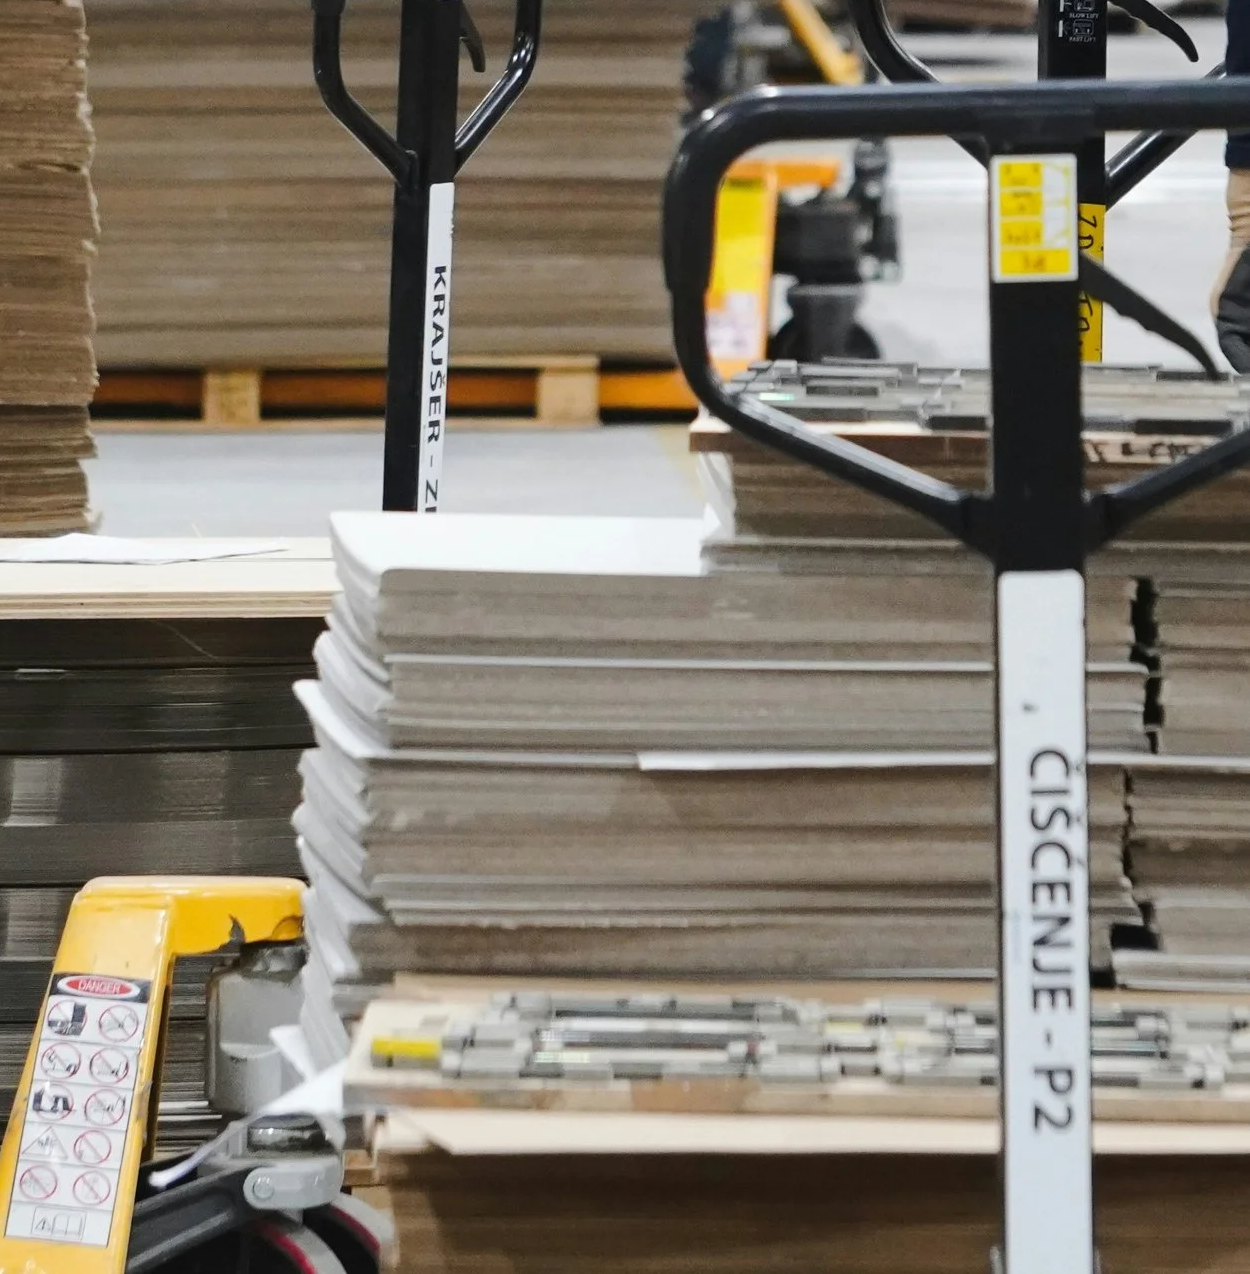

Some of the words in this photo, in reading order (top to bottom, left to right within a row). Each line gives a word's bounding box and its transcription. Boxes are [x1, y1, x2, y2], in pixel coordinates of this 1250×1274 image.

[428, 266, 446, 443] KRAJŠER
[1030, 749, 1086, 1013] ČIŠĆENJE
[78, 980, 121, 994] DANGER
[1033, 1066, 1073, 1133] P2
